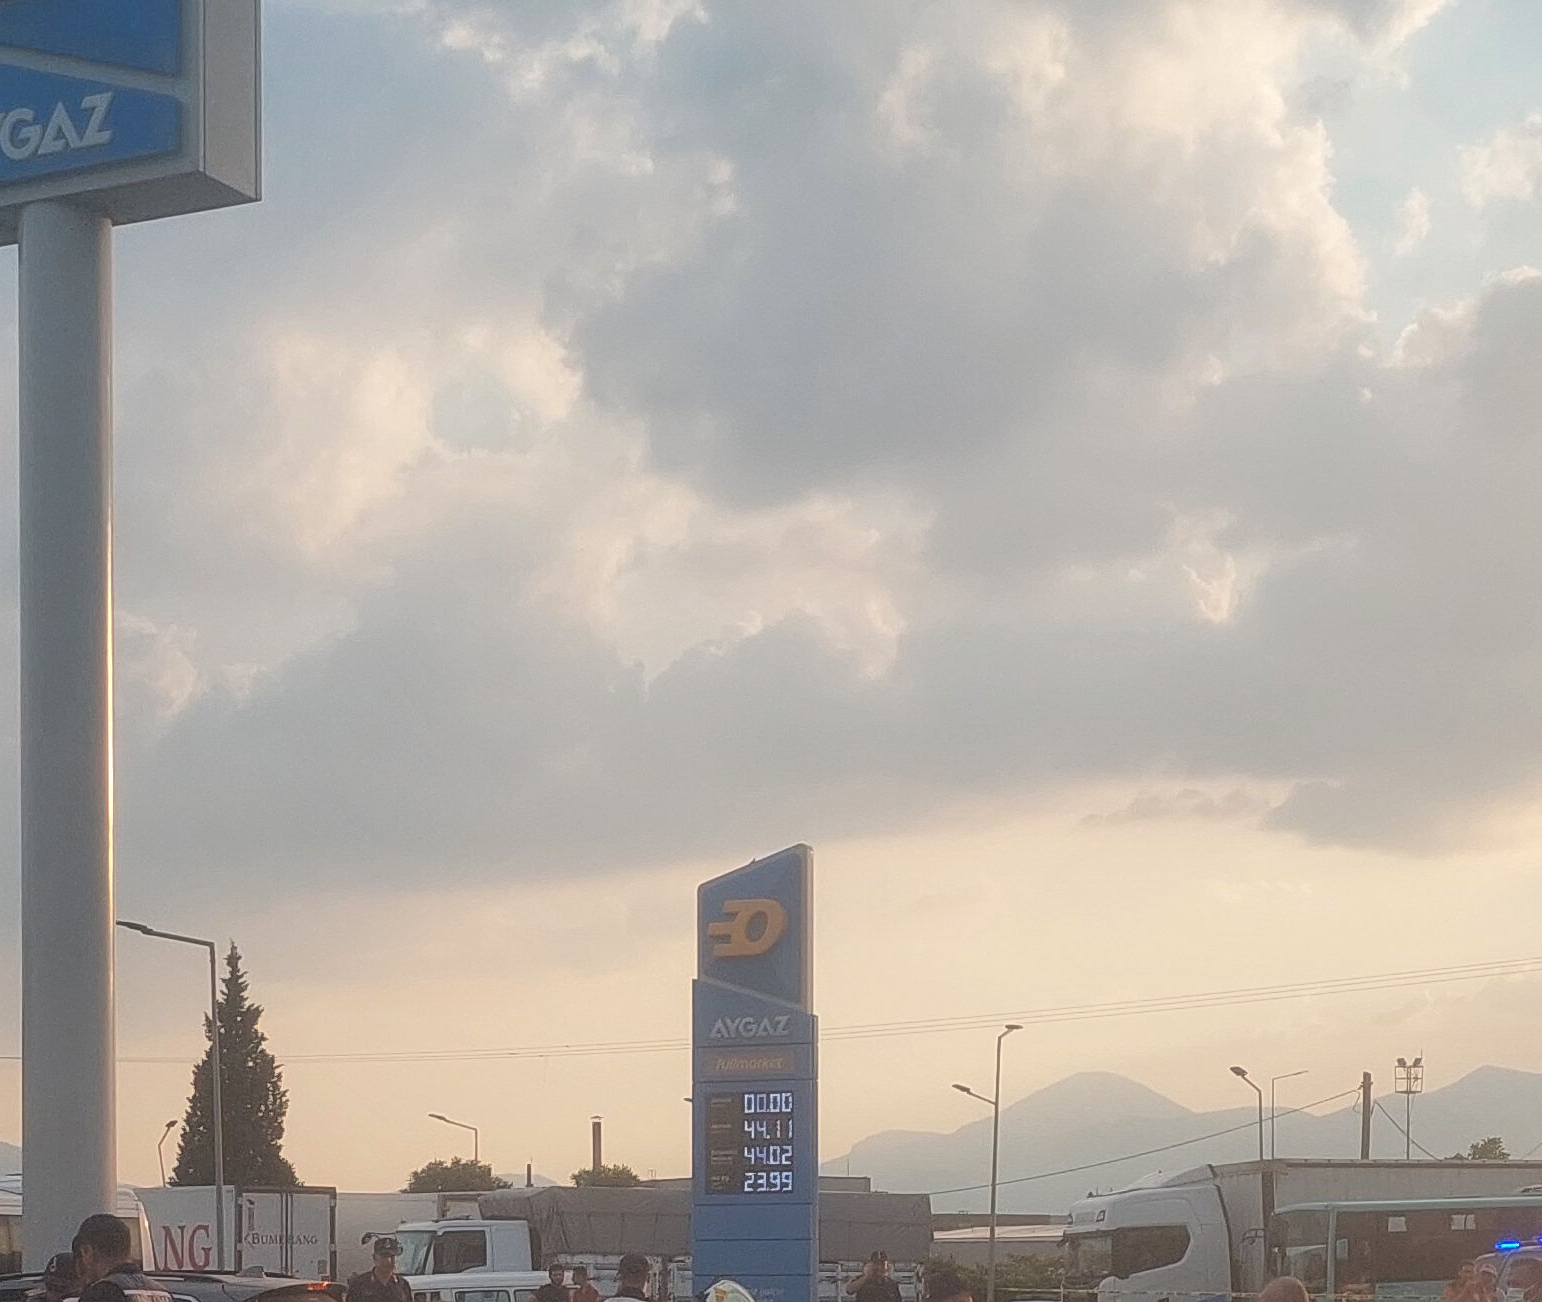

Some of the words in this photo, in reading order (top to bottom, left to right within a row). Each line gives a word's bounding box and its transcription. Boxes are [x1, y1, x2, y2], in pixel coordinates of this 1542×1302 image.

[711, 1015, 790, 1039] AYGAZ
[744, 1119, 793, 1139] 44.11
[744, 1145, 793, 1165] 44.02
[744, 1171, 793, 1192] 23.99
